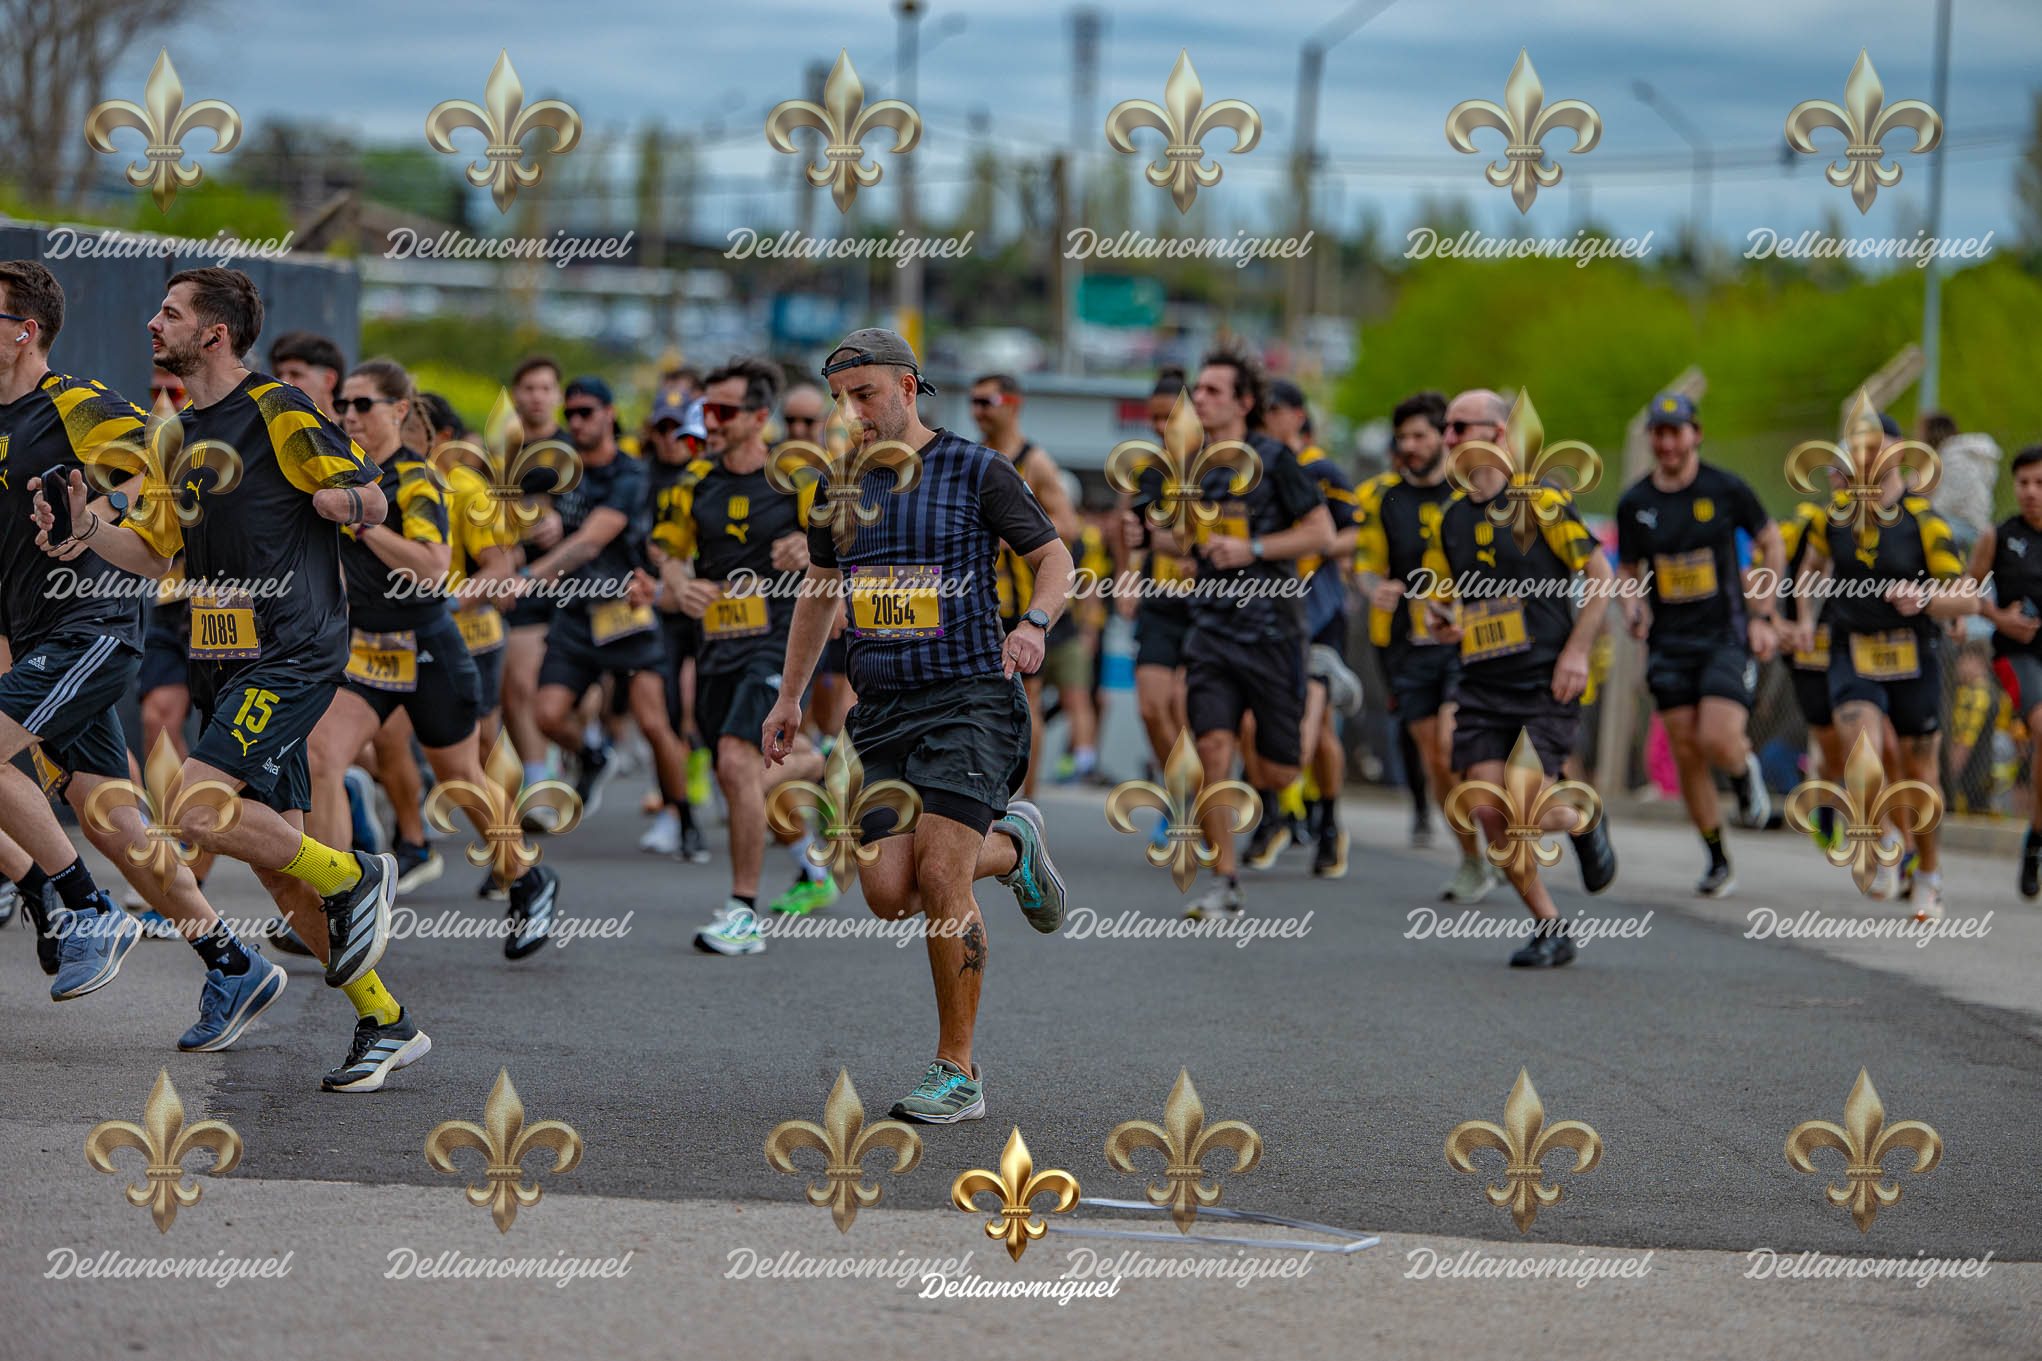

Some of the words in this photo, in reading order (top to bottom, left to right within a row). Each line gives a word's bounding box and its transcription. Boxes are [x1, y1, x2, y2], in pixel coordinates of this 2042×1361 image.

[872, 594, 915, 625] 2054
[201, 613, 238, 646] 2089
[234, 687, 280, 733] 15
